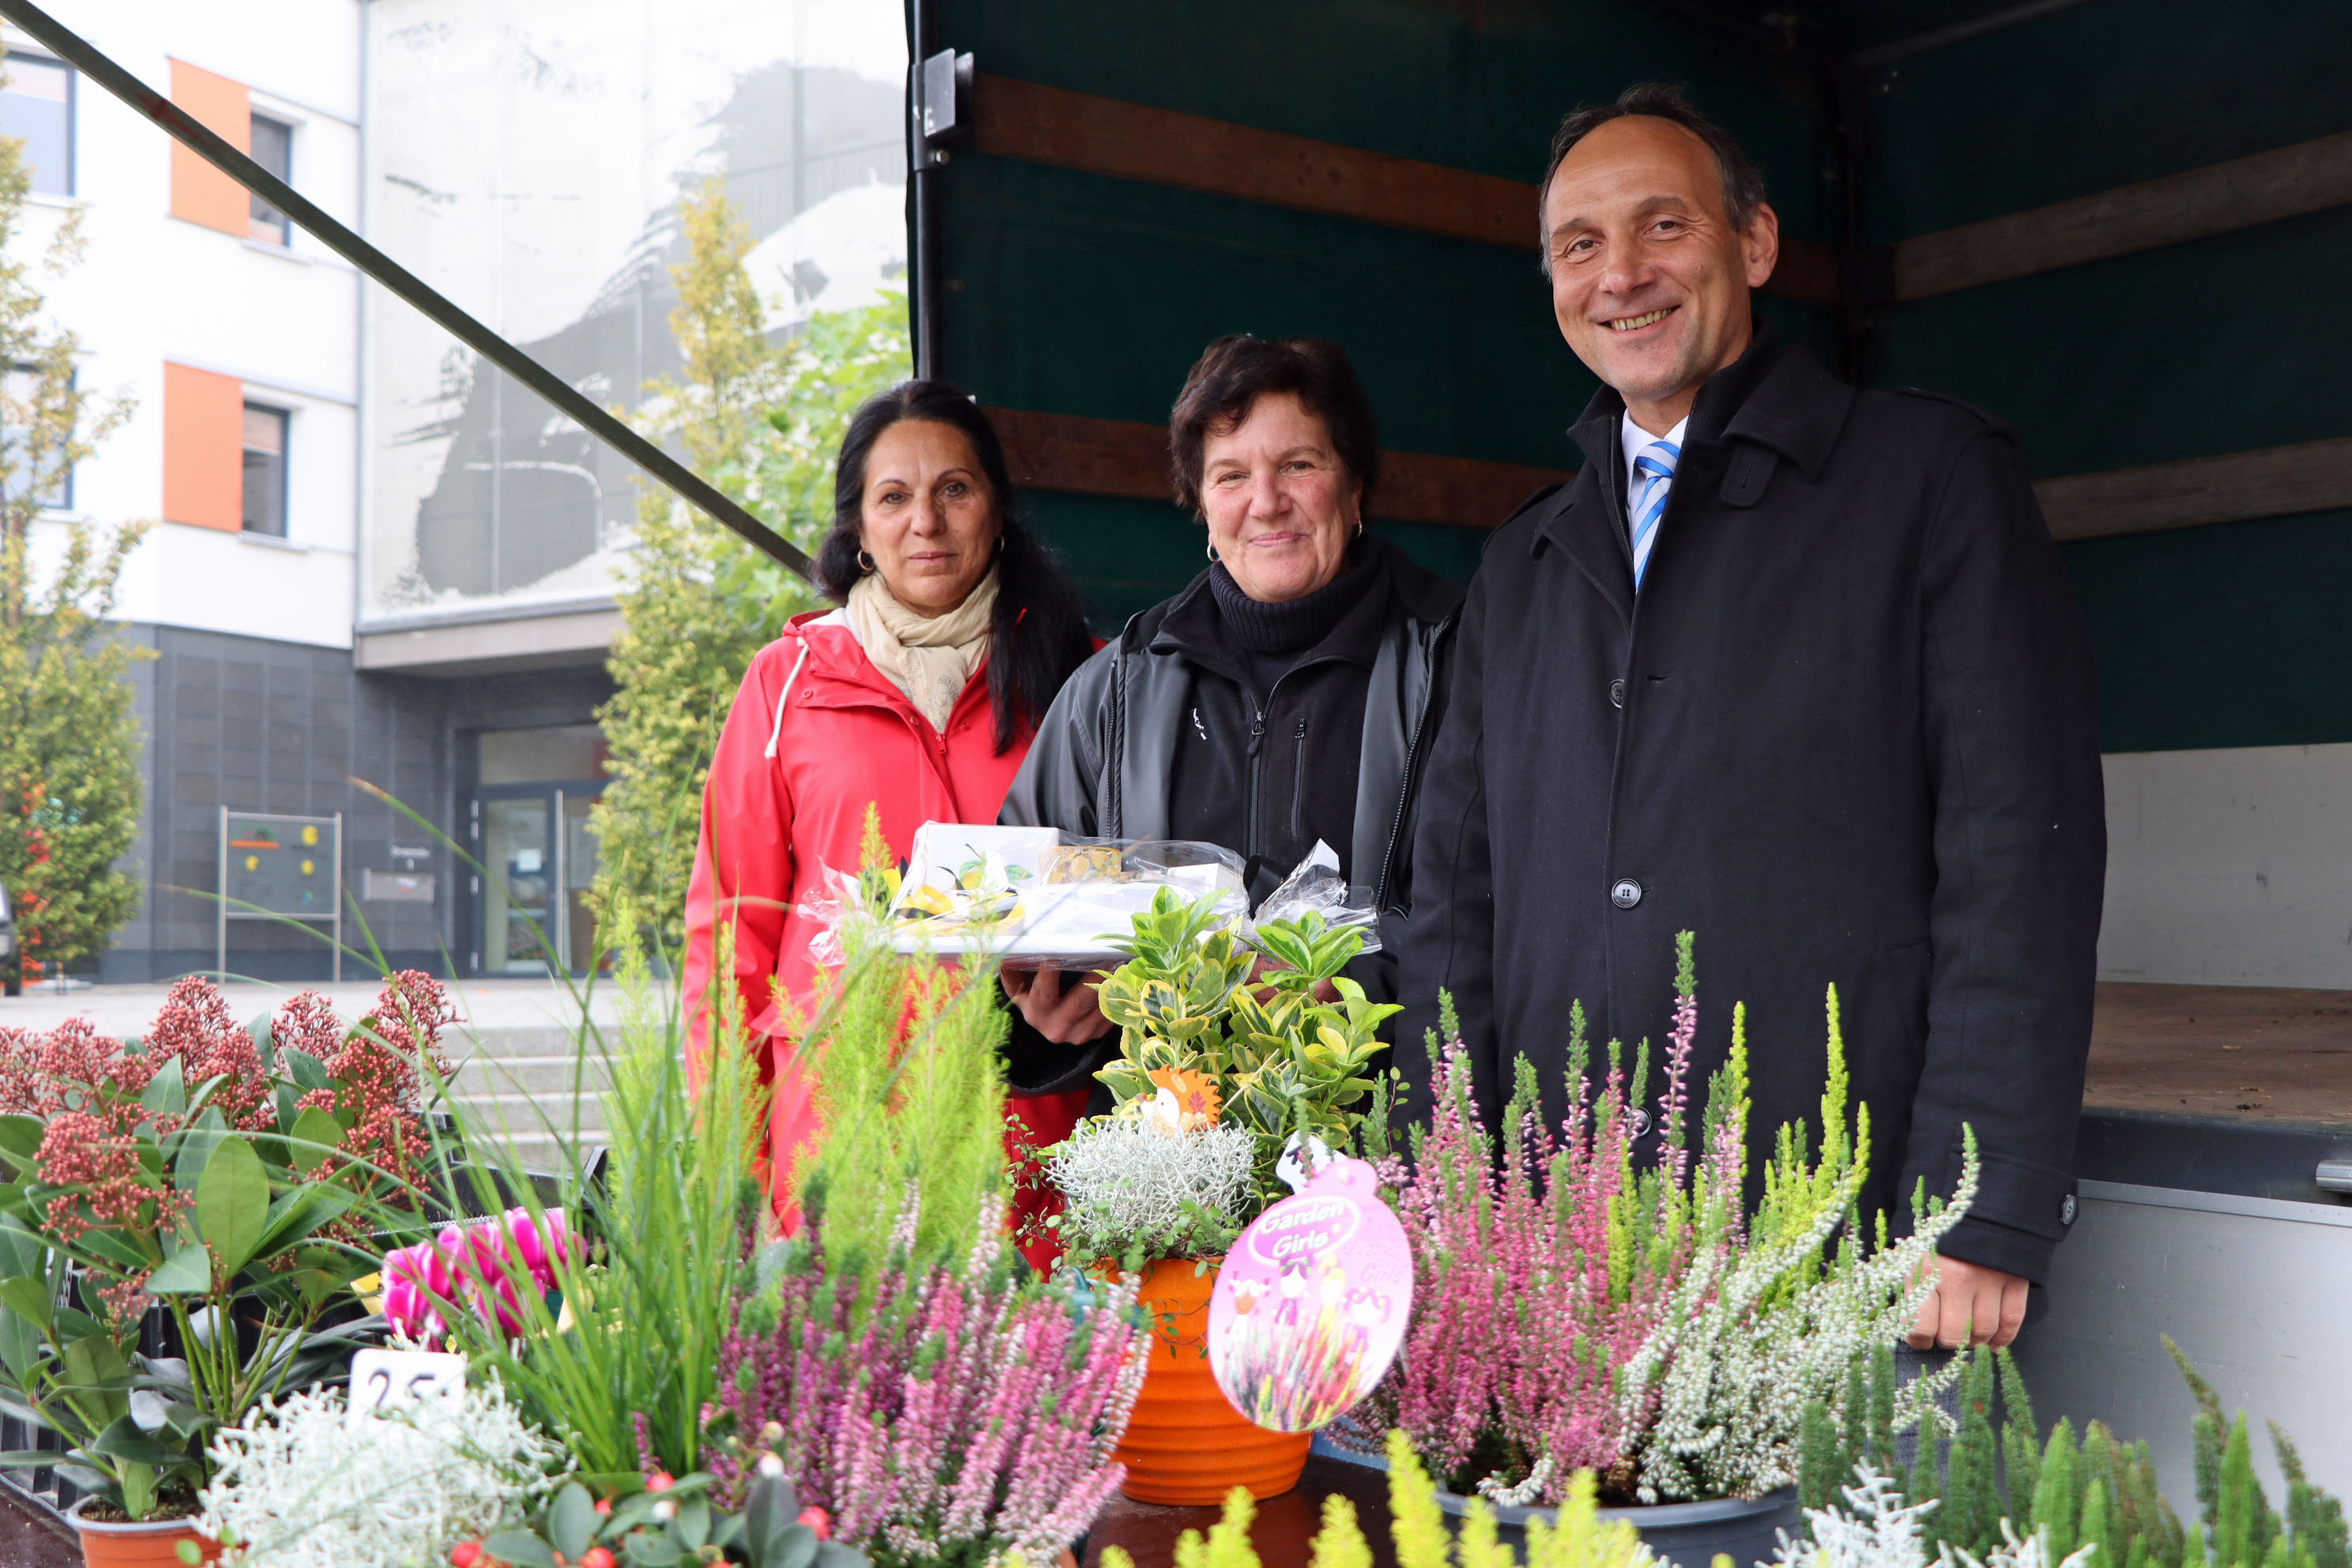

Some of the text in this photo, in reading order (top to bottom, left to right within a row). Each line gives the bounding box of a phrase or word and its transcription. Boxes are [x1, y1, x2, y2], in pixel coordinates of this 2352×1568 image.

[1261, 1201, 1344, 1234] Garden
[1272, 1229, 1329, 1258] Girls
[1359, 1261, 1404, 1283] Girls
